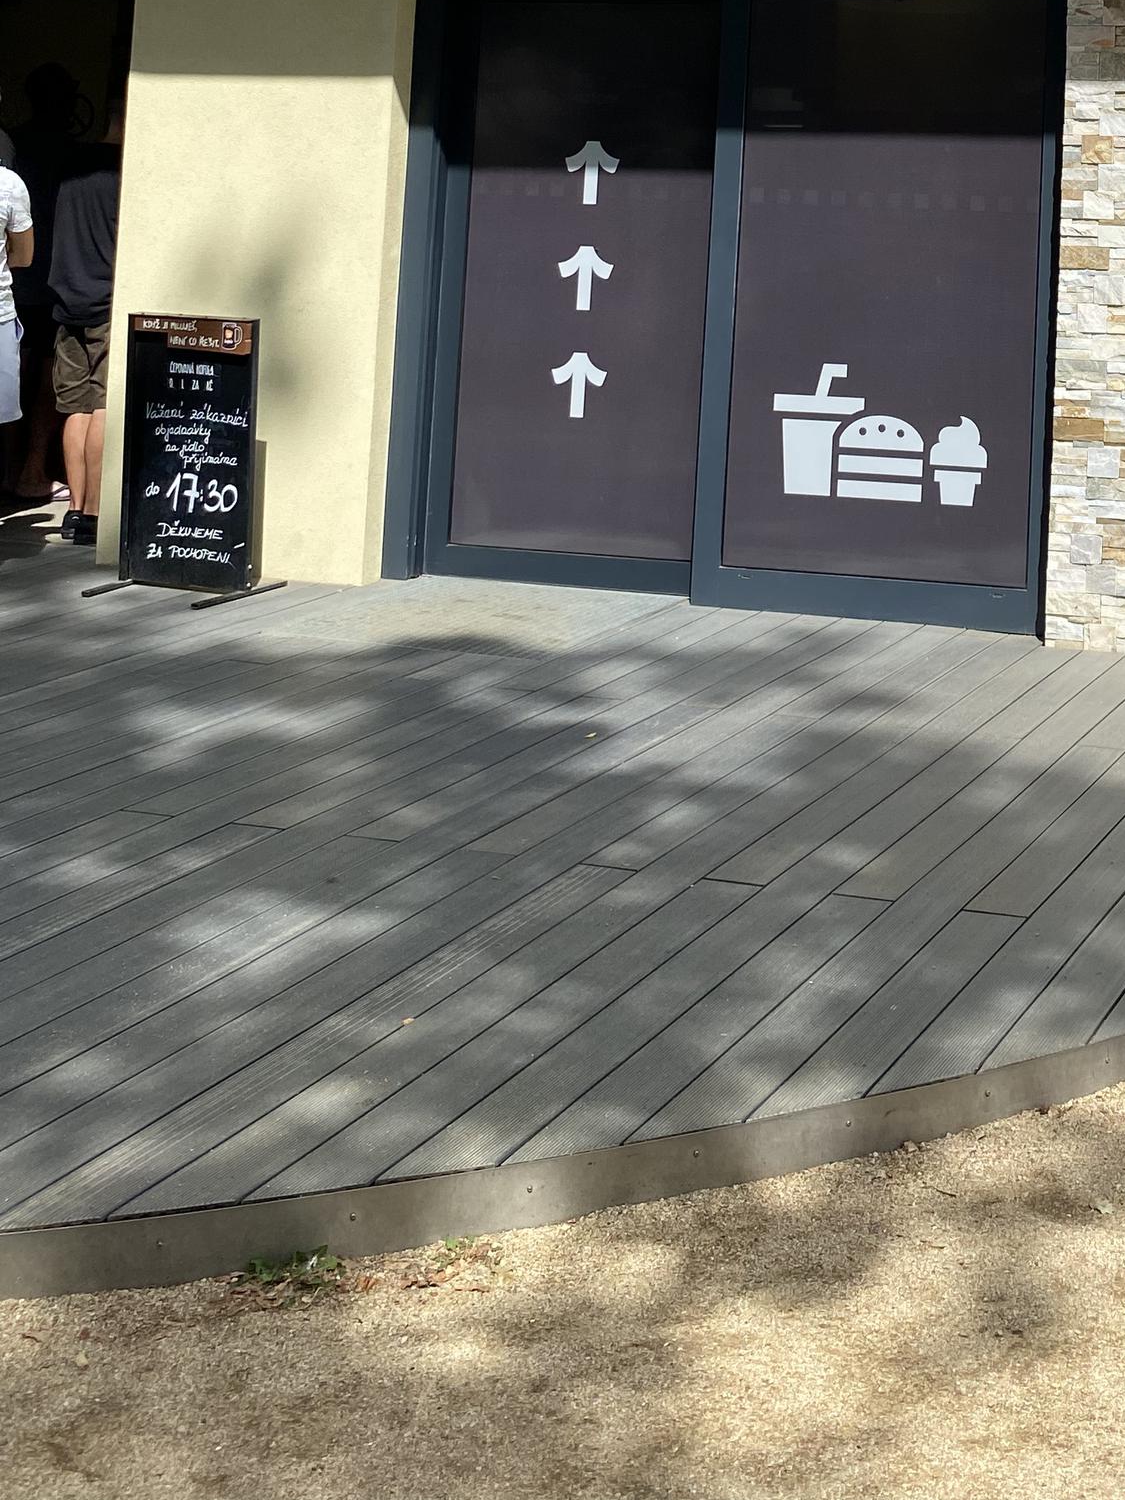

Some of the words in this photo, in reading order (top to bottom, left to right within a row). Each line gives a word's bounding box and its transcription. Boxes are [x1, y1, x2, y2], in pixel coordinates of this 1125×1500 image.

[189, 403, 248, 428] zákazníci
[165, 443, 180, 452] na
[179, 439, 205, 457] jídlo
[145, 481, 160, 498] do
[166, 472, 239, 514] 17:30
[156, 520, 224, 540] DĚKUJEME
[146, 543, 163, 559] ZA
